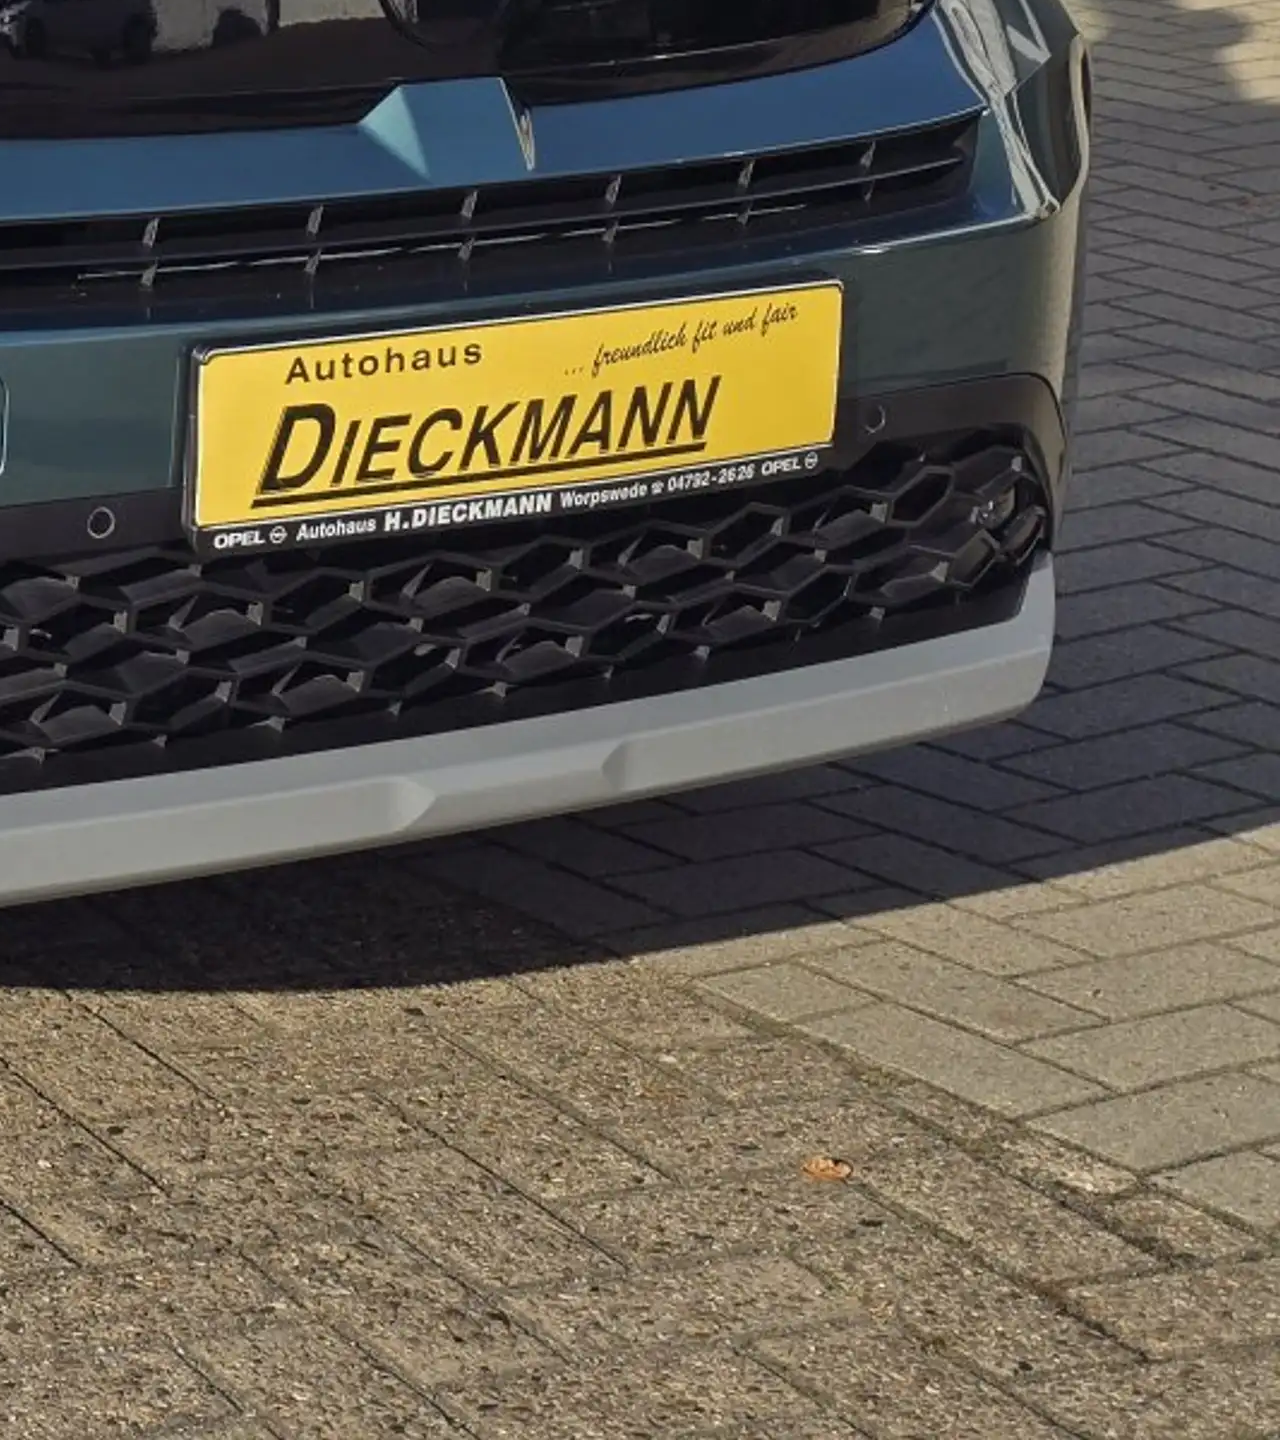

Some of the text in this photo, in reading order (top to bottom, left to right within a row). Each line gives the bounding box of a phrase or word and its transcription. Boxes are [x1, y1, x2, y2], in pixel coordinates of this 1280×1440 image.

[284, 343, 483, 385] Autohaus
[591, 321, 689, 378] freundlich
[691, 318, 718, 354] fit
[722, 307, 757, 337] und
[760, 302, 798, 337] fair
[252, 374, 722, 495] DIECKMANN
[213, 529, 266, 550] OPEL
[295, 517, 377, 542] Autohaus
[560, 480, 647, 510] Worpswede
[761, 456, 802, 477] OPEL
